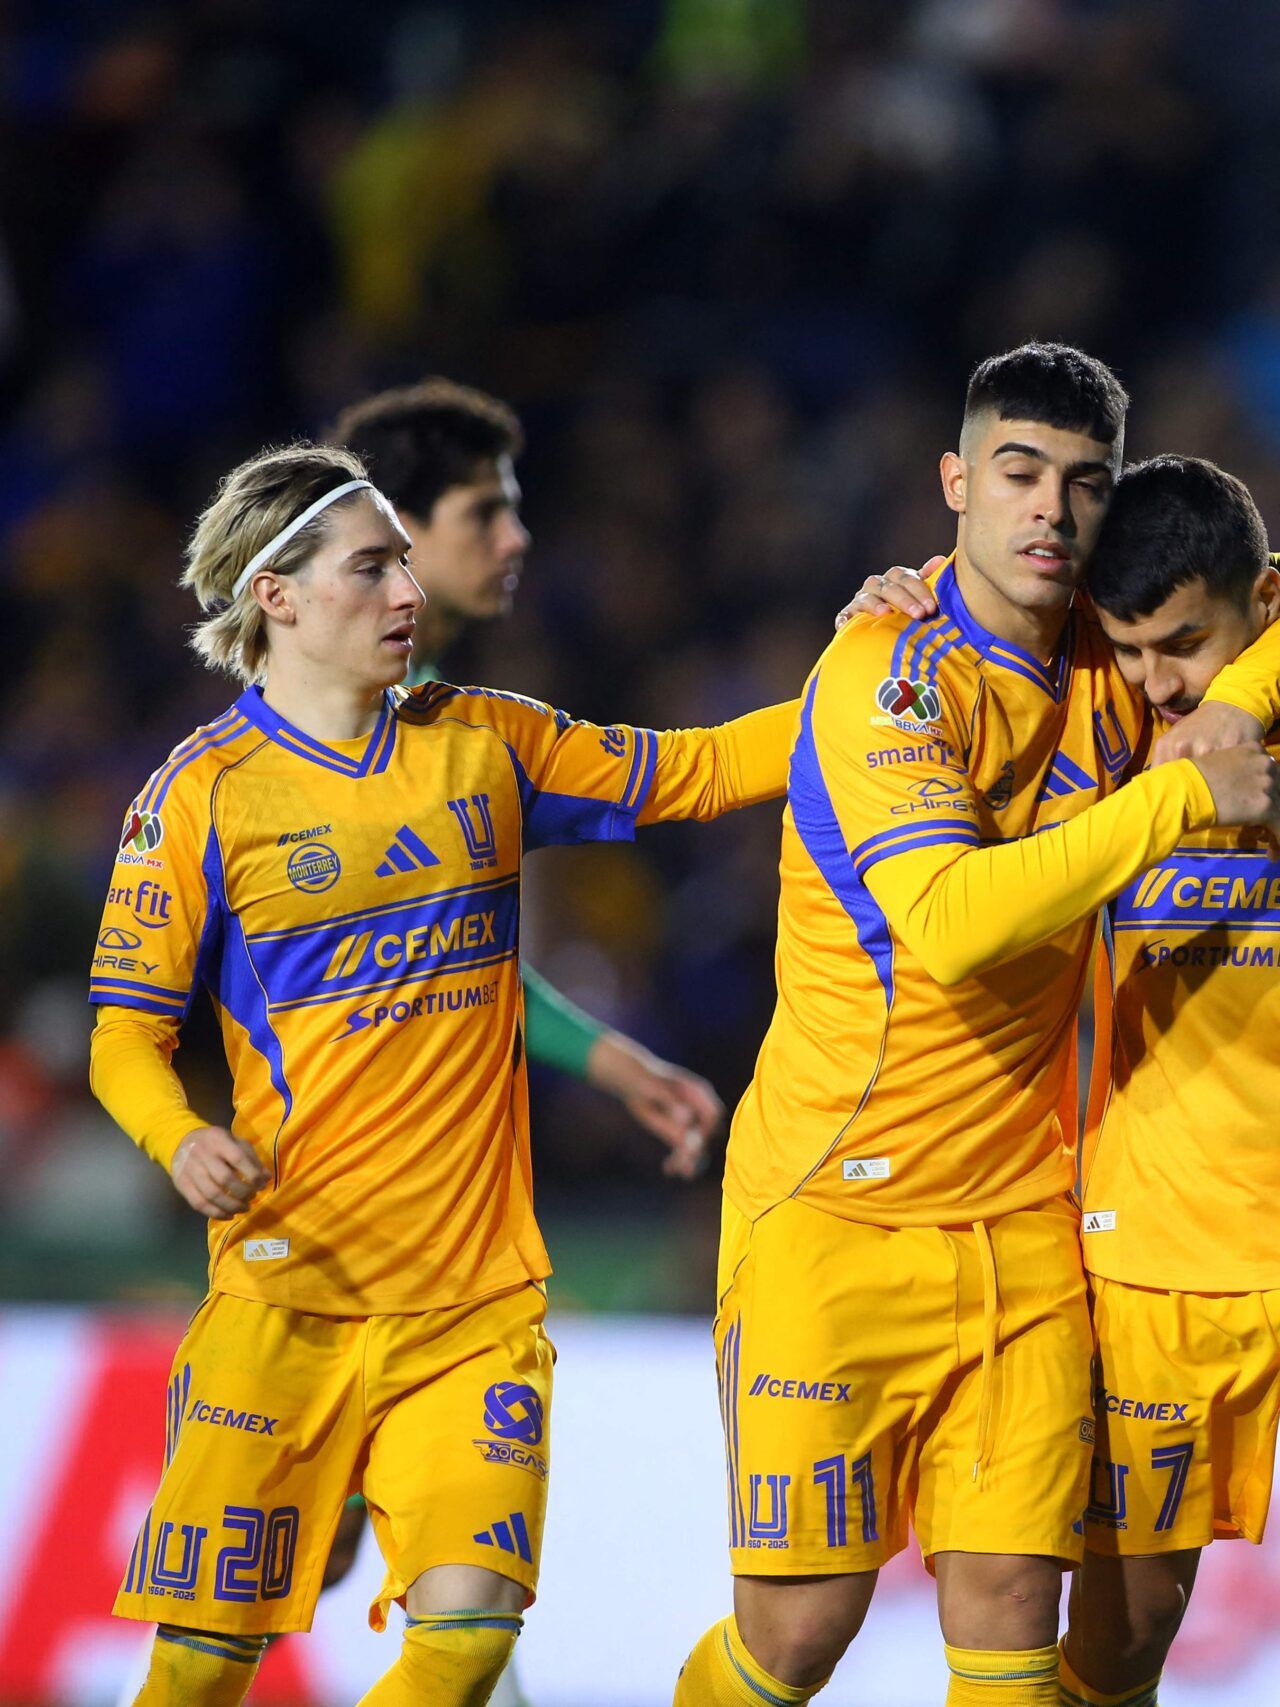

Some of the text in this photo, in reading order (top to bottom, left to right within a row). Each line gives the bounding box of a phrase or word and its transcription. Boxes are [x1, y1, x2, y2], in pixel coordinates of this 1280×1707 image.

[895, 718, 929, 734] BBVA
[866, 743, 935, 769] smart
[290, 824, 333, 844] CEMEX
[147, 859, 163, 869] MX
[288, 855, 339, 881] MONTERREY
[135, 880, 172, 919] fit
[373, 911, 496, 969] CEMEX
[767, 1379, 852, 1402] CEMEX
[197, 1404, 279, 1436] CEMEX
[1105, 1395, 1189, 1421] CEMEX
[813, 1448, 880, 1548] 11
[1151, 1442, 1194, 1532] 7
[213, 1504, 300, 1603] 20
